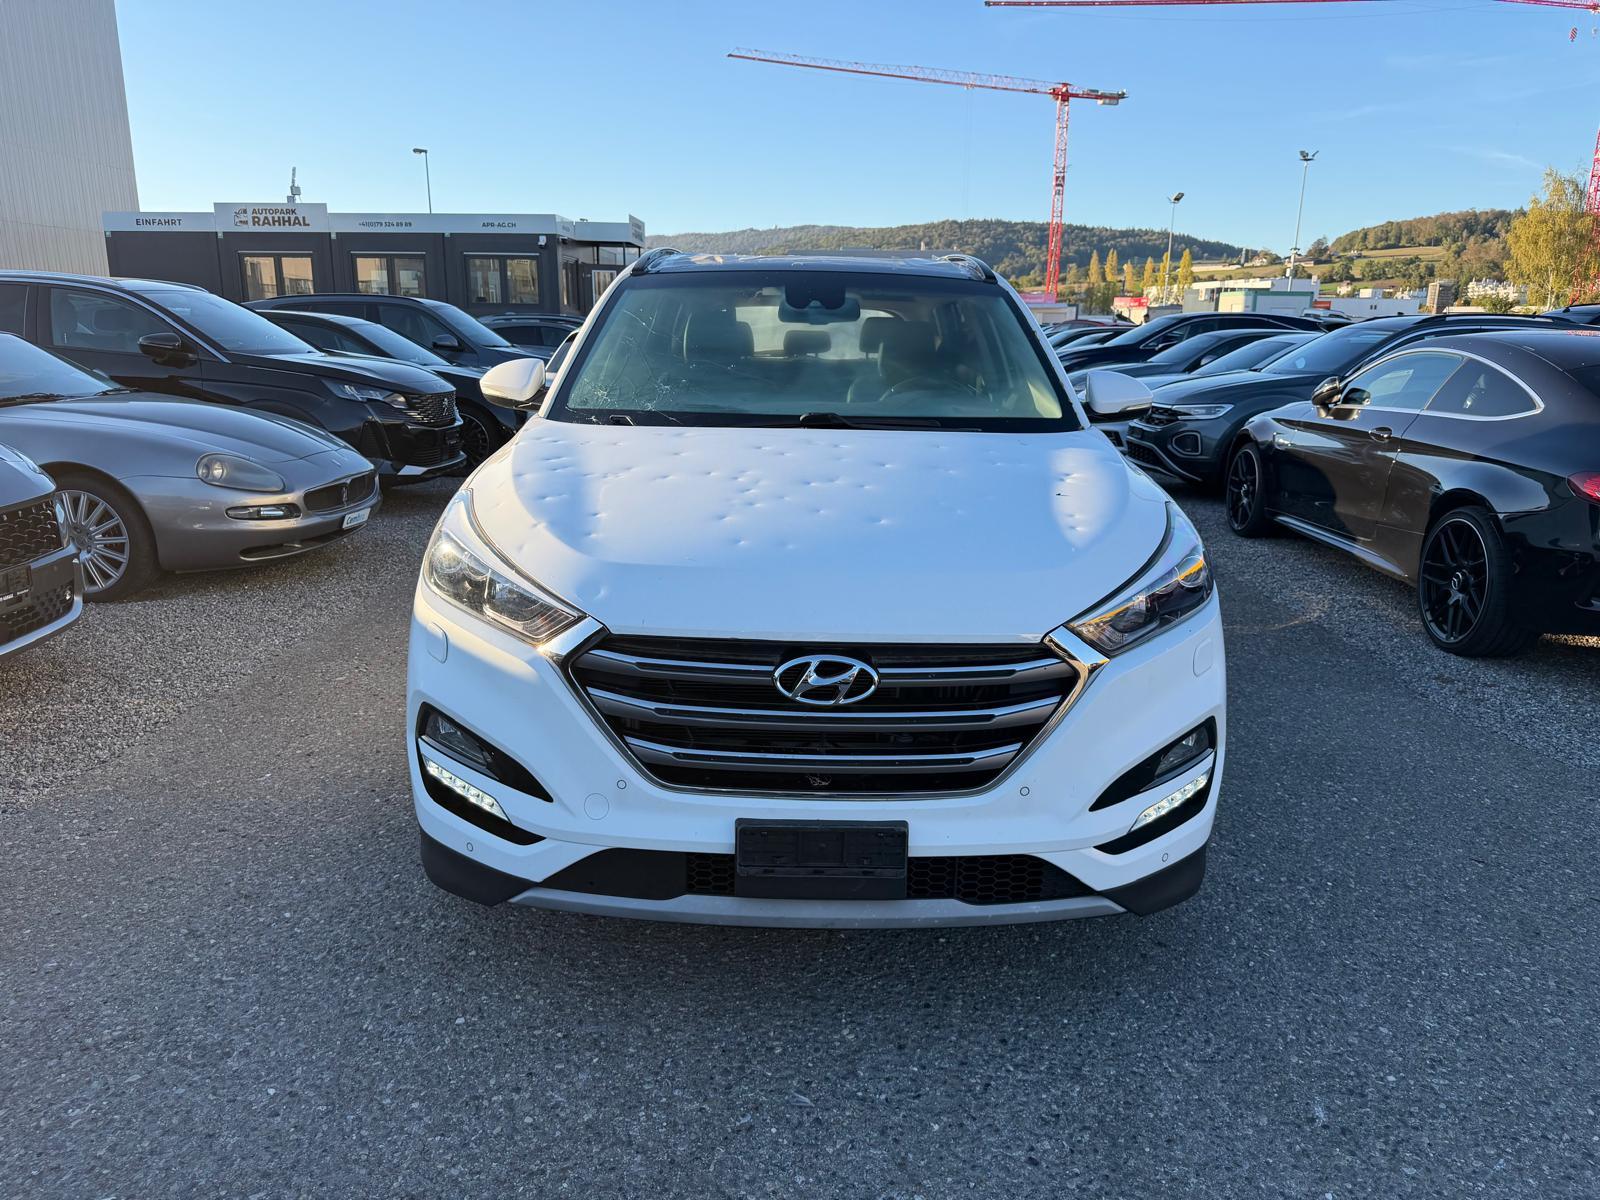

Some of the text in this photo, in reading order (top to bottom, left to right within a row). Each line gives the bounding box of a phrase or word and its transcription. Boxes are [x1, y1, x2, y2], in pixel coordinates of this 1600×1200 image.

[251, 208, 298, 216] AUTOPARK
[135, 217, 183, 227] EINFAHRT
[252, 215, 310, 227] RAHHAL
